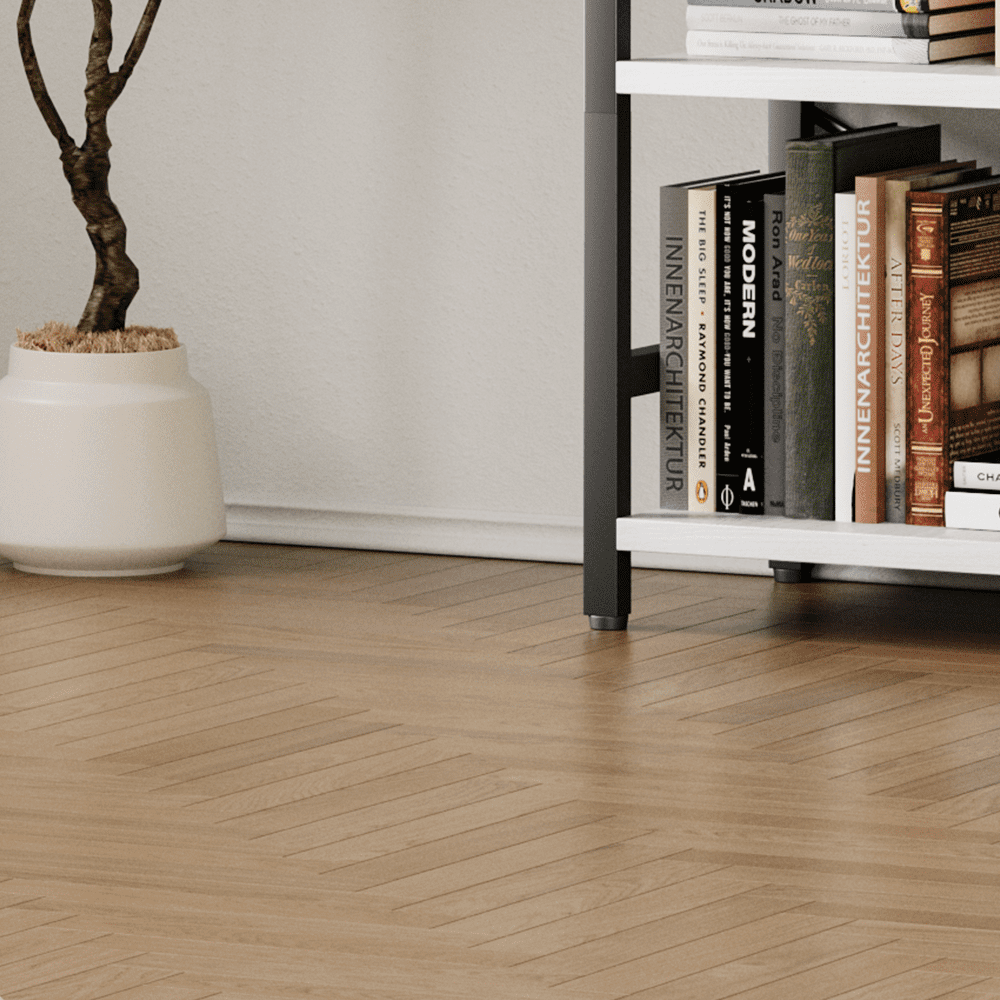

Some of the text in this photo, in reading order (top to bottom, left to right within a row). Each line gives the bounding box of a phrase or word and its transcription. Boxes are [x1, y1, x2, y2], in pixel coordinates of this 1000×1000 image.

[778, 16, 790, 25] THE
[791, 16, 808, 25] GHOST
[828, 18, 851, 26] FATHER
[724, 195, 732, 209] IT'S
[724, 211, 732, 225] NOT
[724, 226, 732, 243] HOW
[698, 210, 706, 304] THE BIG SLEEP
[724, 244, 732, 263] GOOD
[772, 210, 783, 302] Ron Arad
[788, 254, 833, 270] Wedloc
[724, 265, 732, 279] YOU
[742, 219, 756, 338] MODERN
[724, 300, 732, 312] IT'S
[918, 292, 939, 346] JOURNEY
[724, 314, 732, 330] HOW
[856, 198, 871, 474] INNENARCHITEKTUR
[890, 258, 902, 386] AFTER DAYS
[666, 236, 684, 492] INNENARCHITEKTUR
[724, 369, 732, 388] WANT
[698, 323, 706, 468] RAYMOND CHANDLER
[724, 390, 732, 400] TO
[769, 316, 783, 444] No Discipline
[918, 345, 934, 424] UNEXPECTED
[724, 424, 732, 462] Paul Arden
[742, 467, 756, 492] A
[892, 423, 901, 511] SCOTT MEDBURY
